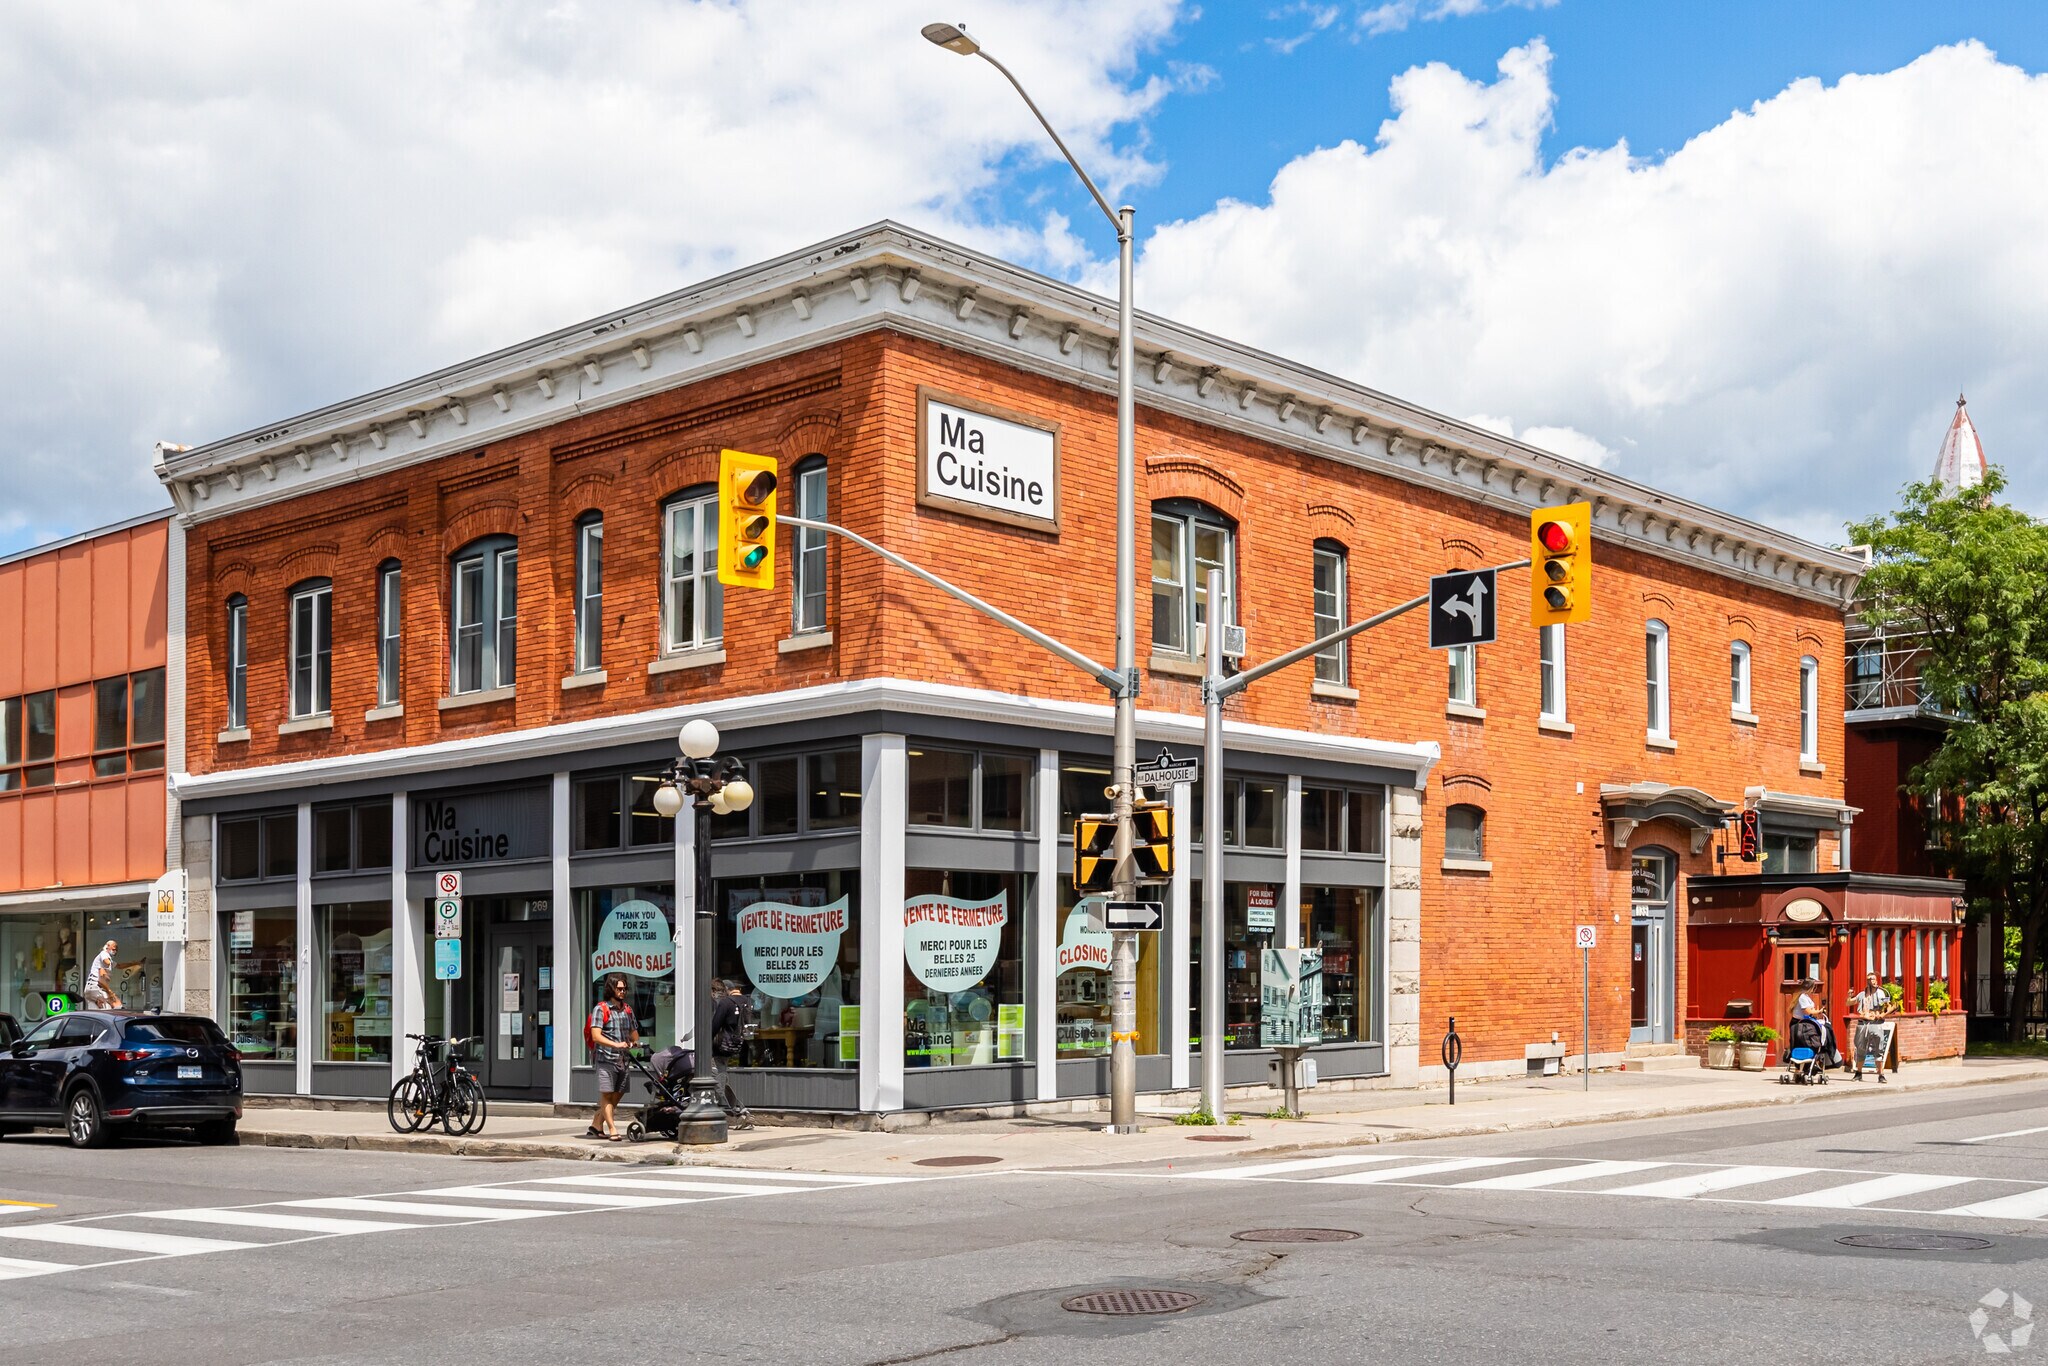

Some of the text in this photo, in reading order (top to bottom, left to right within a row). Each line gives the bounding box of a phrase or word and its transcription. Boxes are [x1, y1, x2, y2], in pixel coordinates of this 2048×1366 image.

[940, 412, 984, 455] Ma
[937, 451, 1043, 505] Cuisine
[1144, 769, 1189, 782] DALHOUSIE
[425, 801, 456, 832] Ma
[1741, 809, 1757, 858] BAR
[424, 828, 509, 863] Cuisine
[1640, 868, 1656, 880] Lauzon
[1260, 890, 1274, 898] RENT
[1636, 885, 1651, 896] Murray
[532, 901, 548, 912] 269
[1255, 898, 1273, 906] LOUER
[616, 911, 656, 920] THANK YOU
[741, 909, 844, 934] VENTE DE FERMETURE
[904, 903, 1004, 928] VENTE DE FERMETURE
[622, 920, 649, 929] FOR 25
[613, 931, 657, 940] WONDERFUL YEARS
[920, 939, 988, 951] MERCI POUR LES
[754, 946, 823, 957] MERCI POUR LES
[1060, 944, 1108, 965] CLOSING
[595, 949, 672, 972] CLOSING SALE
[934, 953, 976, 964] BELLES 25
[766, 960, 809, 970] BELLES 25
[925, 965, 983, 978] DERNIERES ANNEES
[758, 973, 818, 983] DERNIERES ANNEES
[906, 1018, 926, 1031] Ma
[1057, 1013, 1075, 1024] Ma
[331, 1021, 344, 1032] Ma
[330, 1033, 361, 1044] Cuisine
[905, 1032, 952, 1045] Cuisine
[1056, 1026, 1097, 1040] Cuisine
